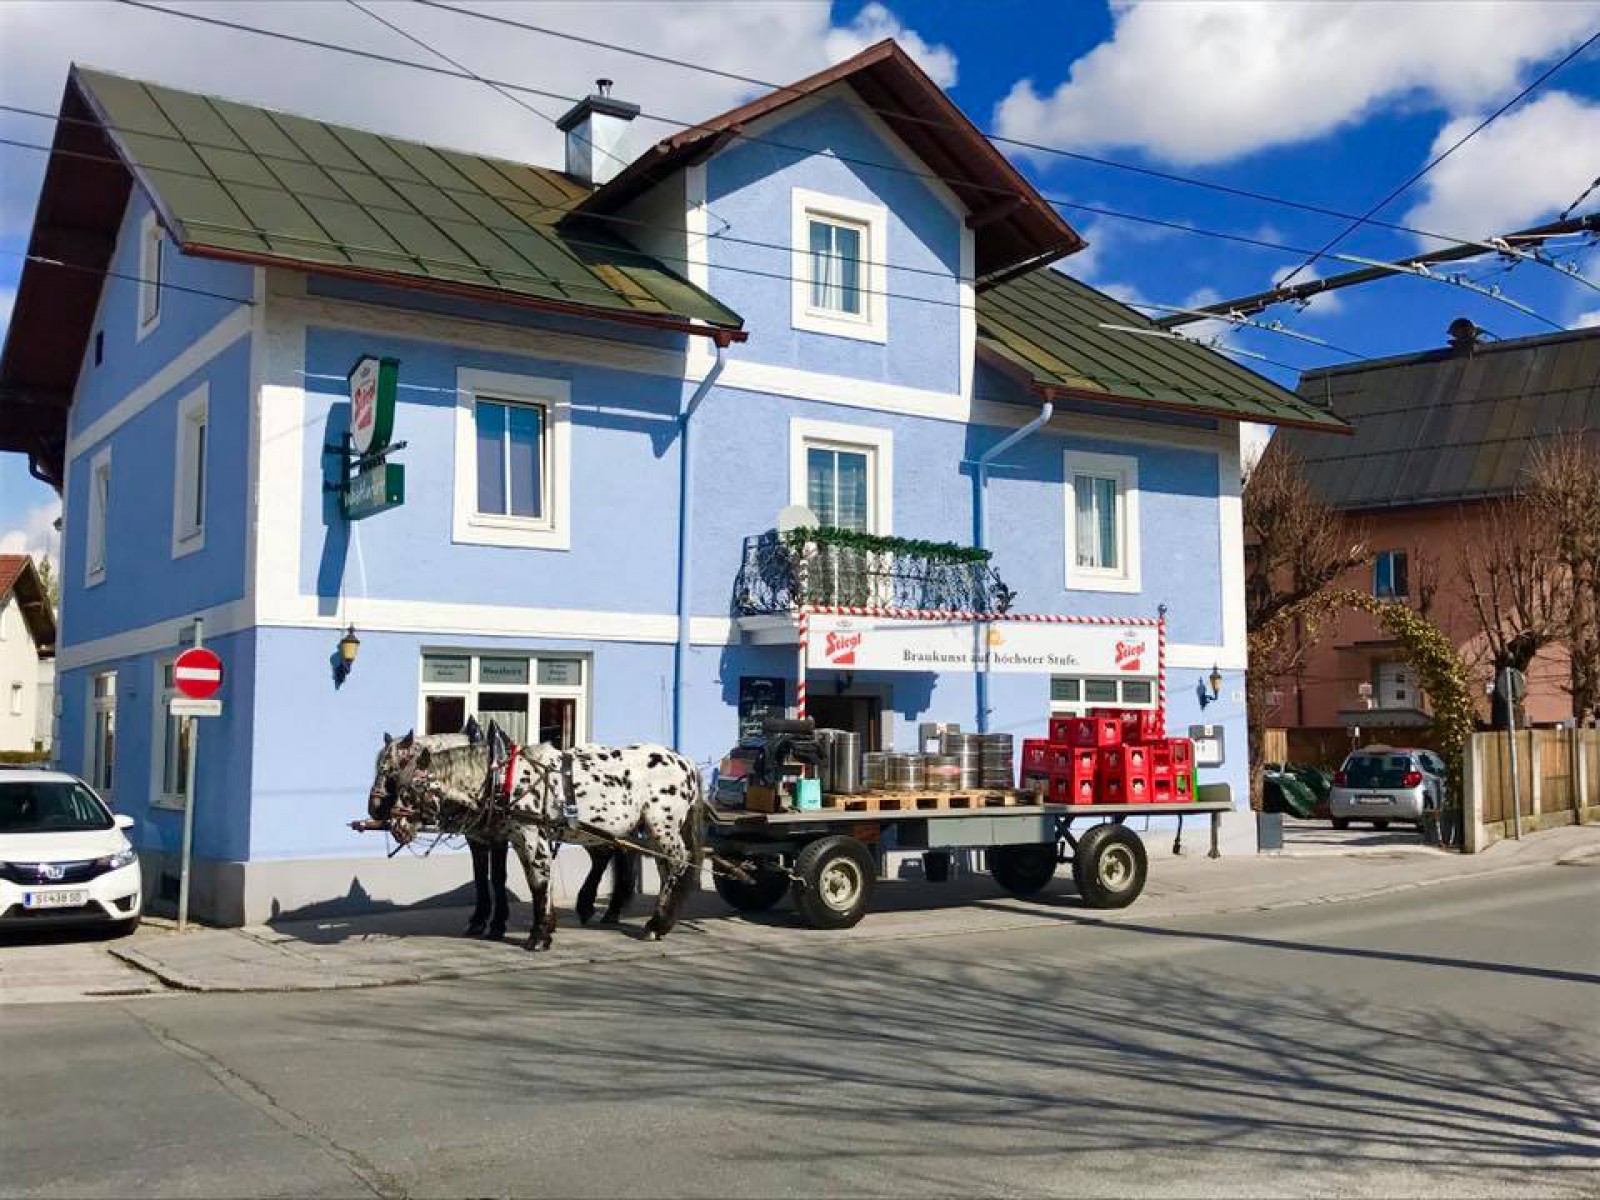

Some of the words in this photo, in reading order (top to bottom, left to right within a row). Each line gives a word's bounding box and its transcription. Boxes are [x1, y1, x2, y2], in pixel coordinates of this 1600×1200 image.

[826, 632, 862, 656] Stiegl
[1115, 641, 1146, 664] Stiegl
[902, 650, 967, 663] Braukunst
[971, 652, 990, 664] auf
